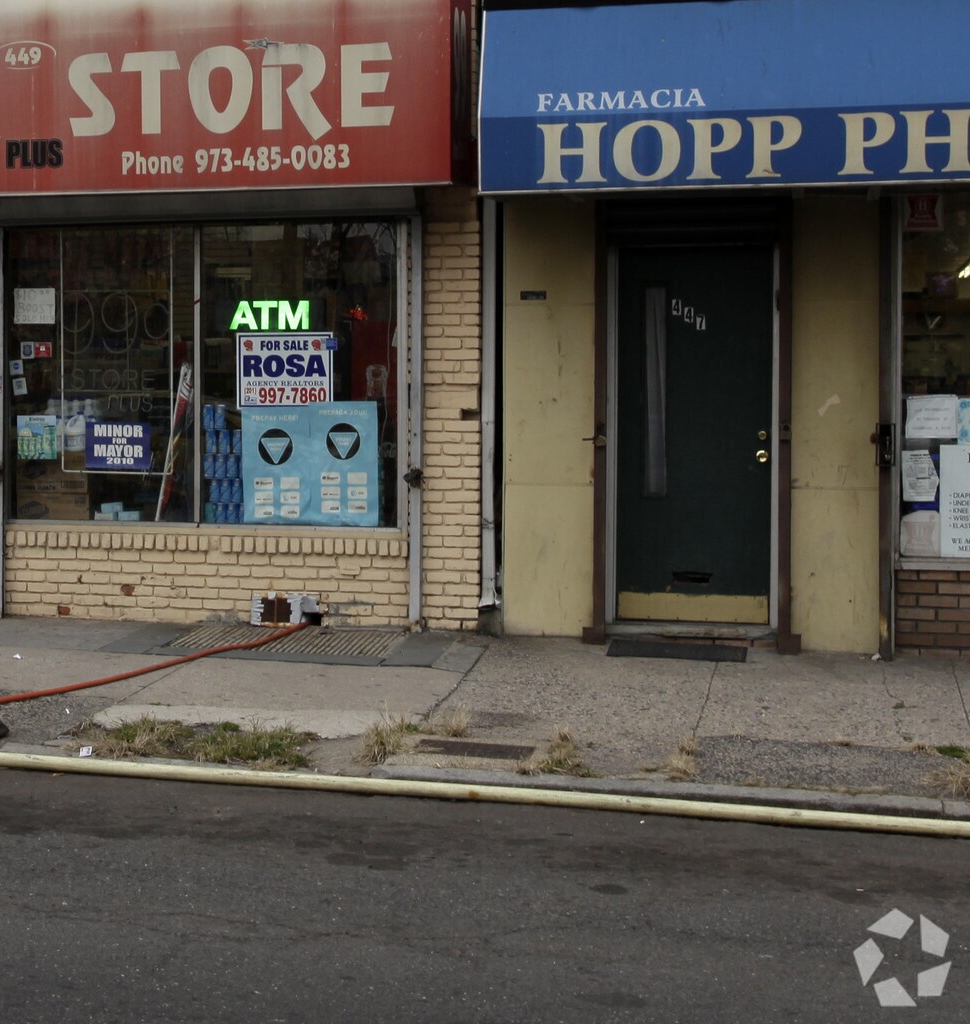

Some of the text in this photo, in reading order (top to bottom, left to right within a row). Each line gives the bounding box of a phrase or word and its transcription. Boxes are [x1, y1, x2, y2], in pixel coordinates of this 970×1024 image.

[5, 45, 41, 67] 449
[68, 42, 396, 141] STORE
[537, 88, 707, 113] FARMACIA
[5, 138, 64, 169] PLUS
[122, 144, 351, 175] Phone 973-485-0083
[536, 115, 803, 185] HOPP
[229, 300, 310, 330] ATM
[672, 299, 704, 329] 447
[260, 340, 309, 351] FOR SALE
[243, 354, 327, 378] ROSA
[258, 387, 327, 404] 997-7860
[93, 424, 143, 438] MINOR
[93, 444, 143, 458] MAYOR
[106, 457, 134, 465] 2010
